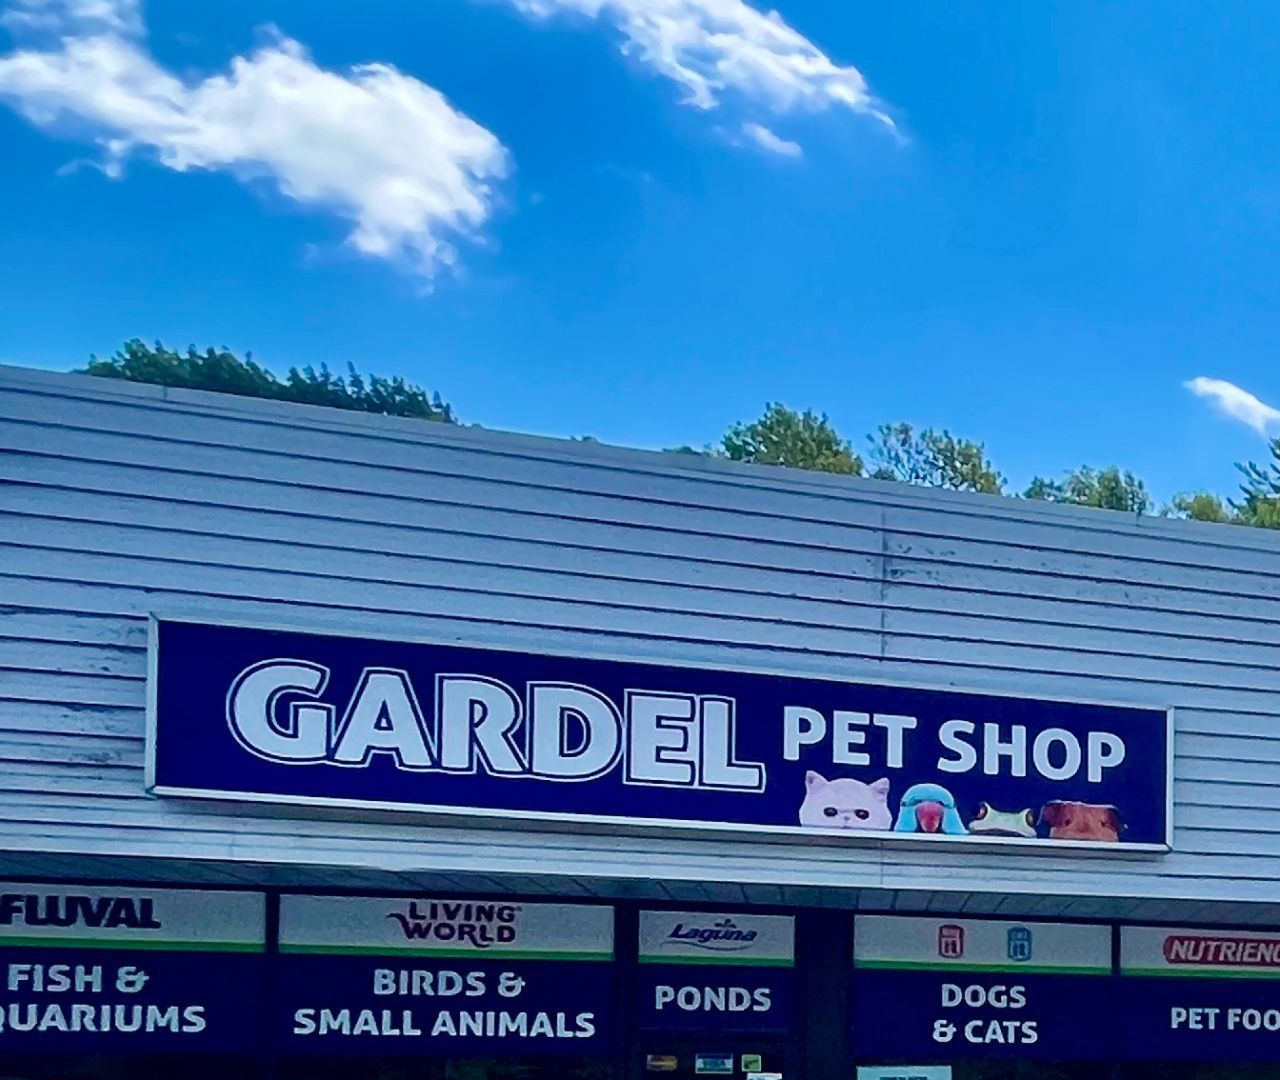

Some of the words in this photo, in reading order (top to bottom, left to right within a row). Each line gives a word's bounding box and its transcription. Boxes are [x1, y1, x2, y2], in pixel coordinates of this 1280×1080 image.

[226, 657, 766, 794] GARDEL
[782, 705, 917, 768] PET
[937, 719, 1126, 783] SHOP
[0, 894, 161, 929] FLUVAL
[408, 901, 516, 923] LIVING
[385, 913, 516, 948] WORLD
[668, 922, 758, 943] Laguna
[8, 964, 102, 992] FISH
[115, 966, 149, 993] &
[373, 969, 486, 996] BIRDS
[498, 971, 526, 997] &
[655, 985, 771, 1011] PONDS
[942, 983, 1026, 1008] DOGS
[0, 1003, 206, 1033] UARIUMS
[293, 1009, 421, 1036] SMALL
[431, 1010, 596, 1038] ANIMALS
[932, 1019, 957, 1043] &
[964, 1019, 1038, 1044] CATS
[1170, 1007, 1220, 1030] PET
